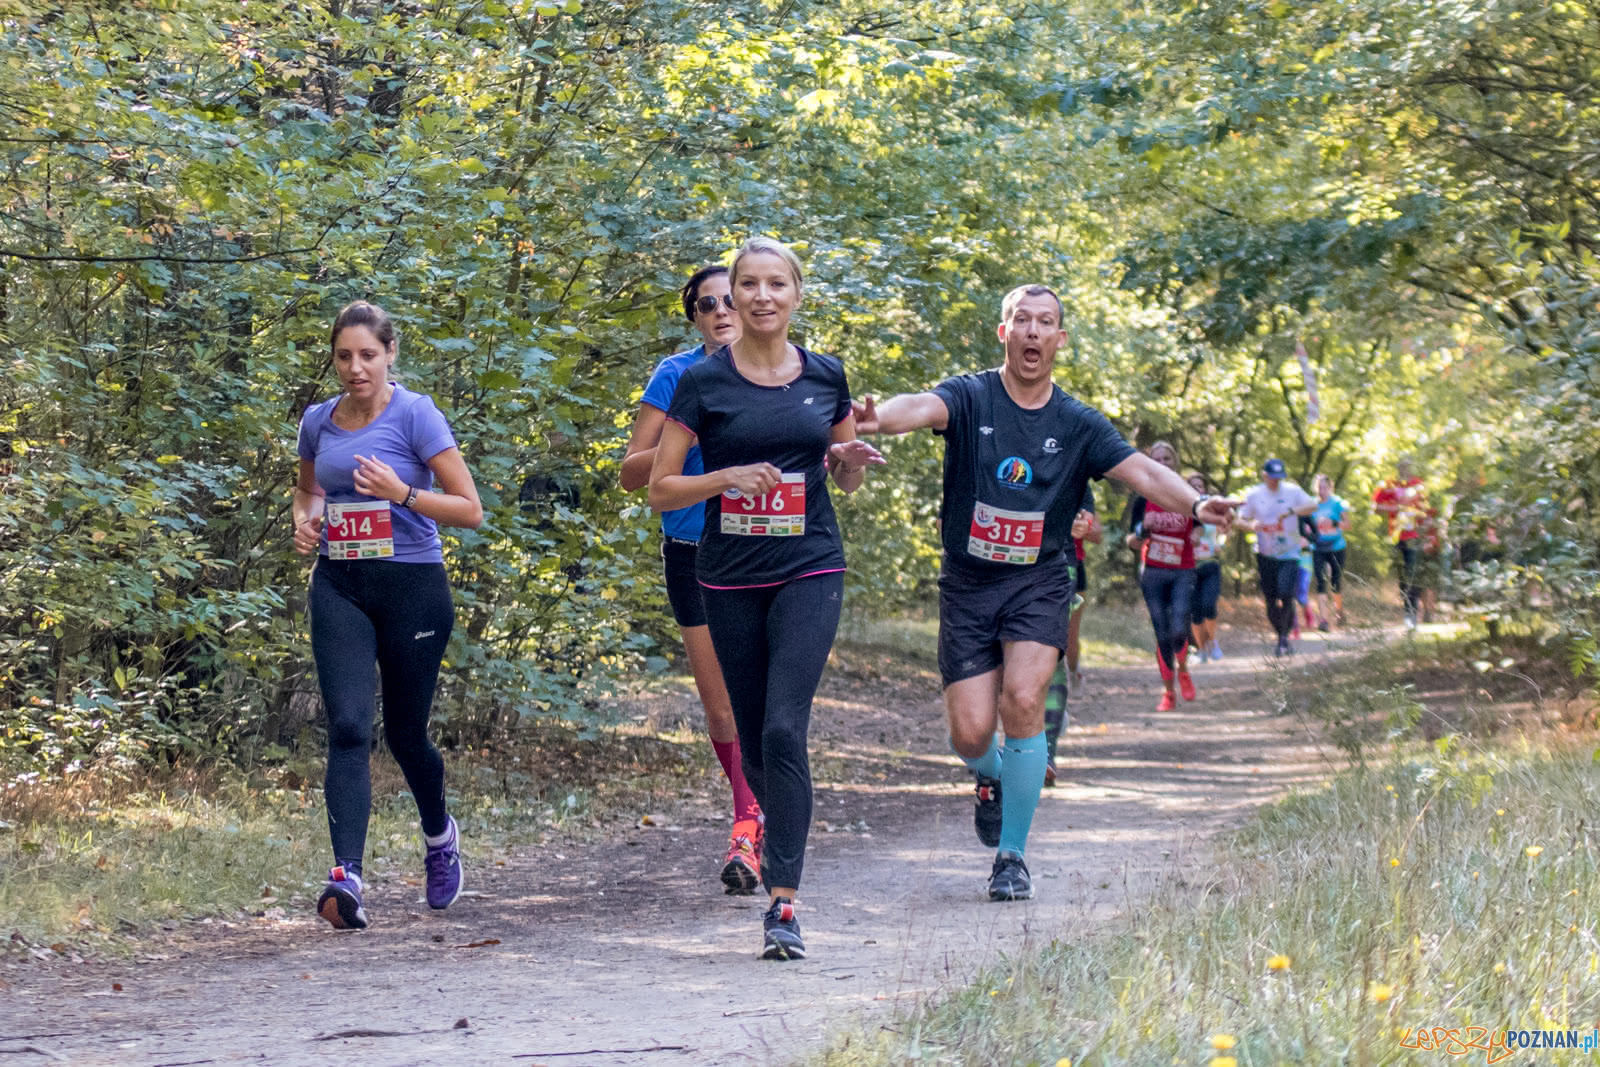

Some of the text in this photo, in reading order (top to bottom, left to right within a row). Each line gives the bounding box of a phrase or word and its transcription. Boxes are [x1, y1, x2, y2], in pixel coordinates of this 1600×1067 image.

[741, 490, 785, 512] 316
[339, 516, 373, 537] 314
[987, 521, 1027, 544] 315
